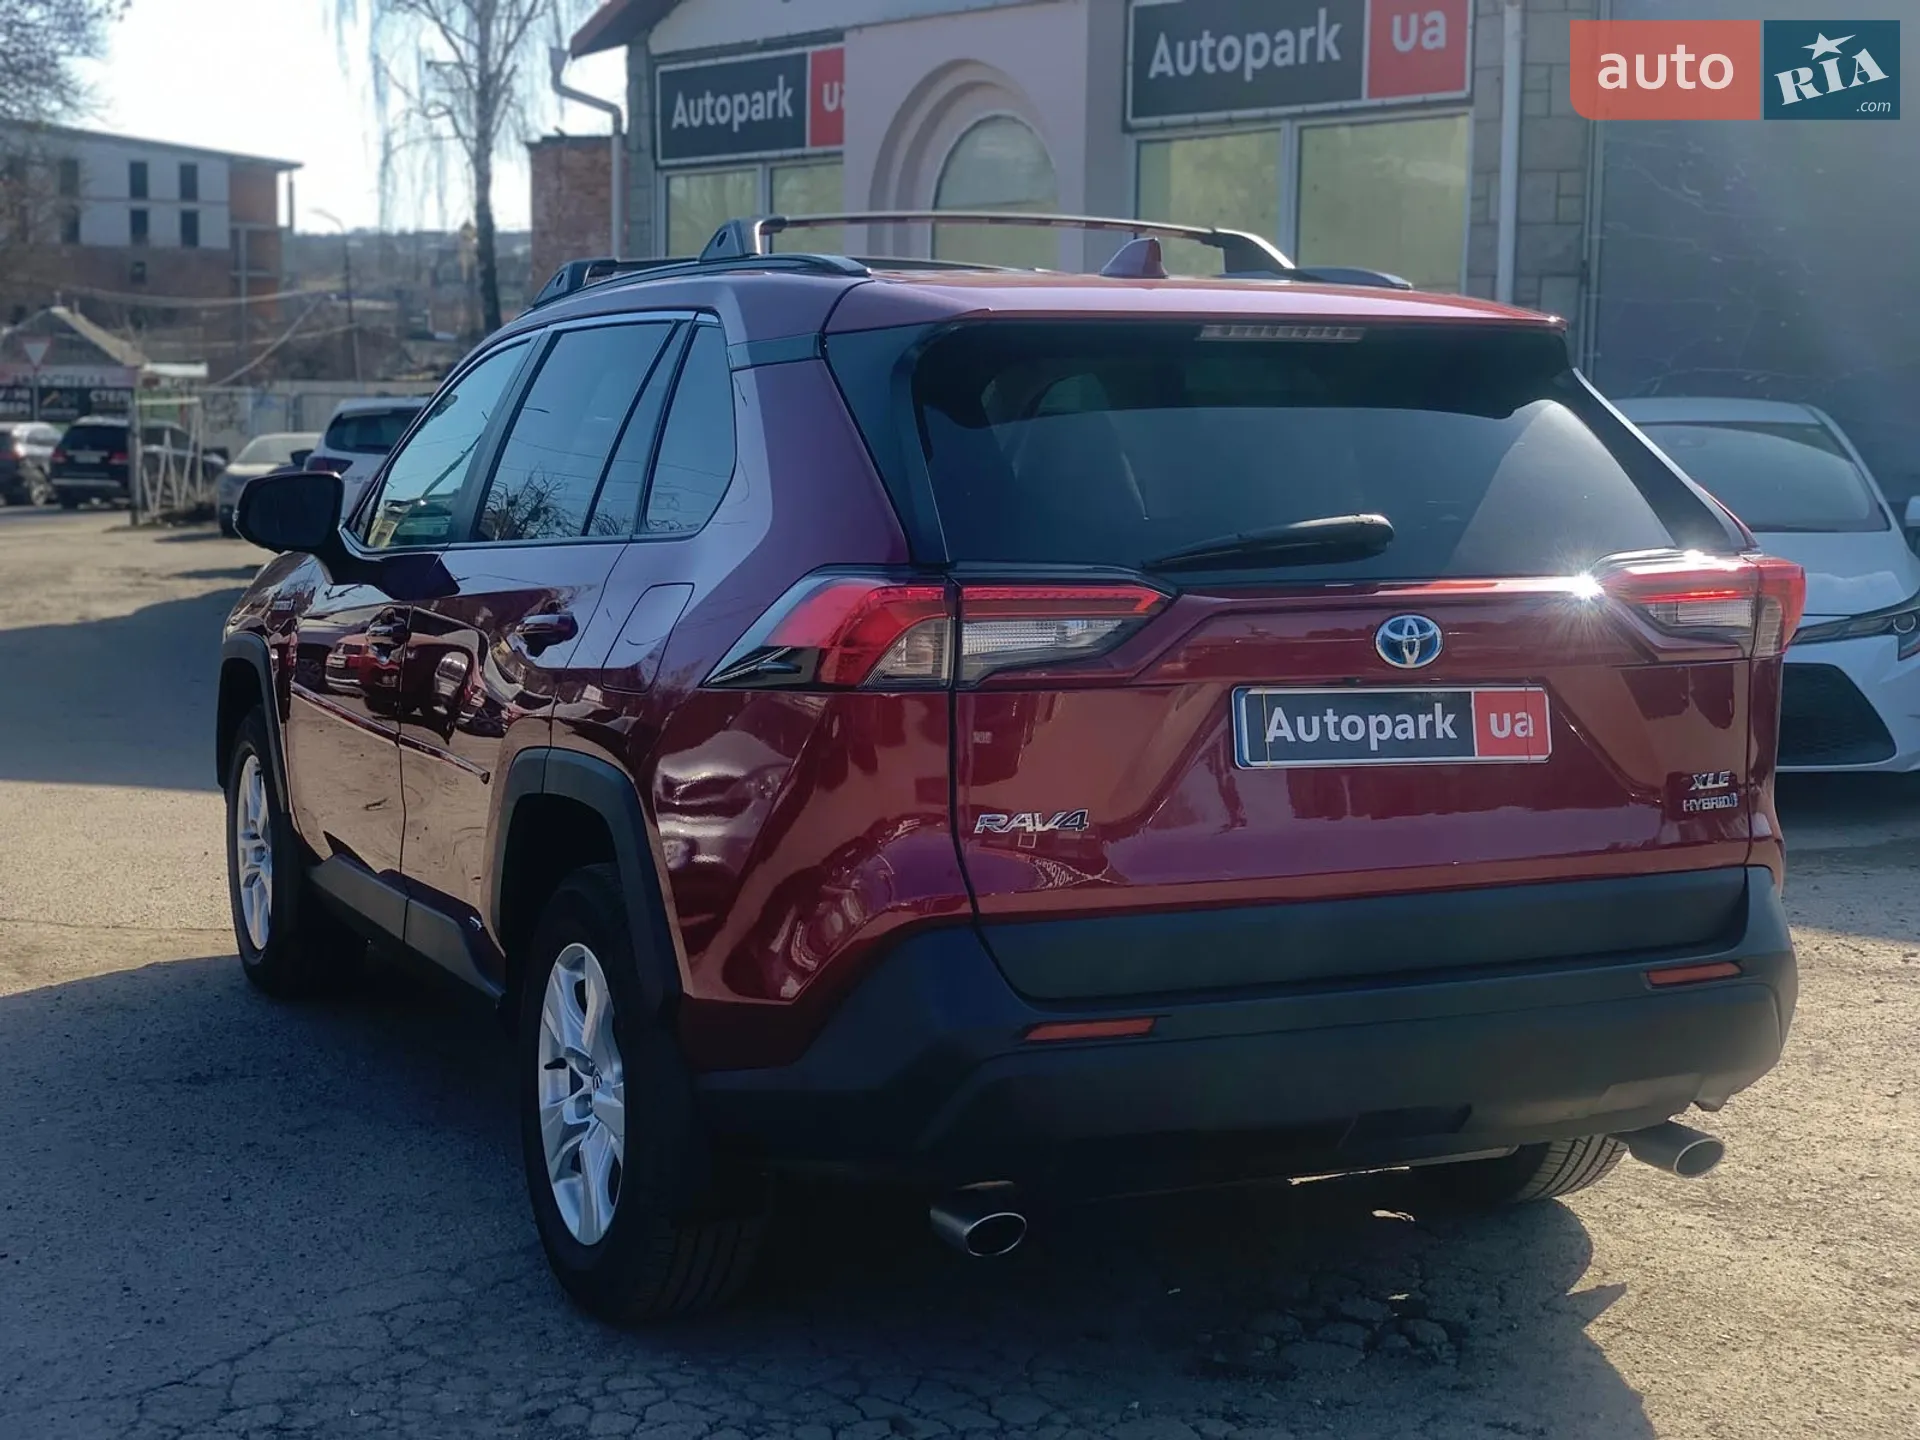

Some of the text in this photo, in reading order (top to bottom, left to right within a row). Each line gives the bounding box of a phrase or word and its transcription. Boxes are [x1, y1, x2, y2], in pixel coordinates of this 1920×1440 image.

[1148, 7, 1447, 82] Autopark ua
[671, 74, 844, 133] Autopark u
[1265, 703, 1534, 751] Autopark ua
[1689, 771, 1731, 790] XLE
[974, 809, 1090, 834] RAV4
[1683, 796, 1732, 812] HYBRID
